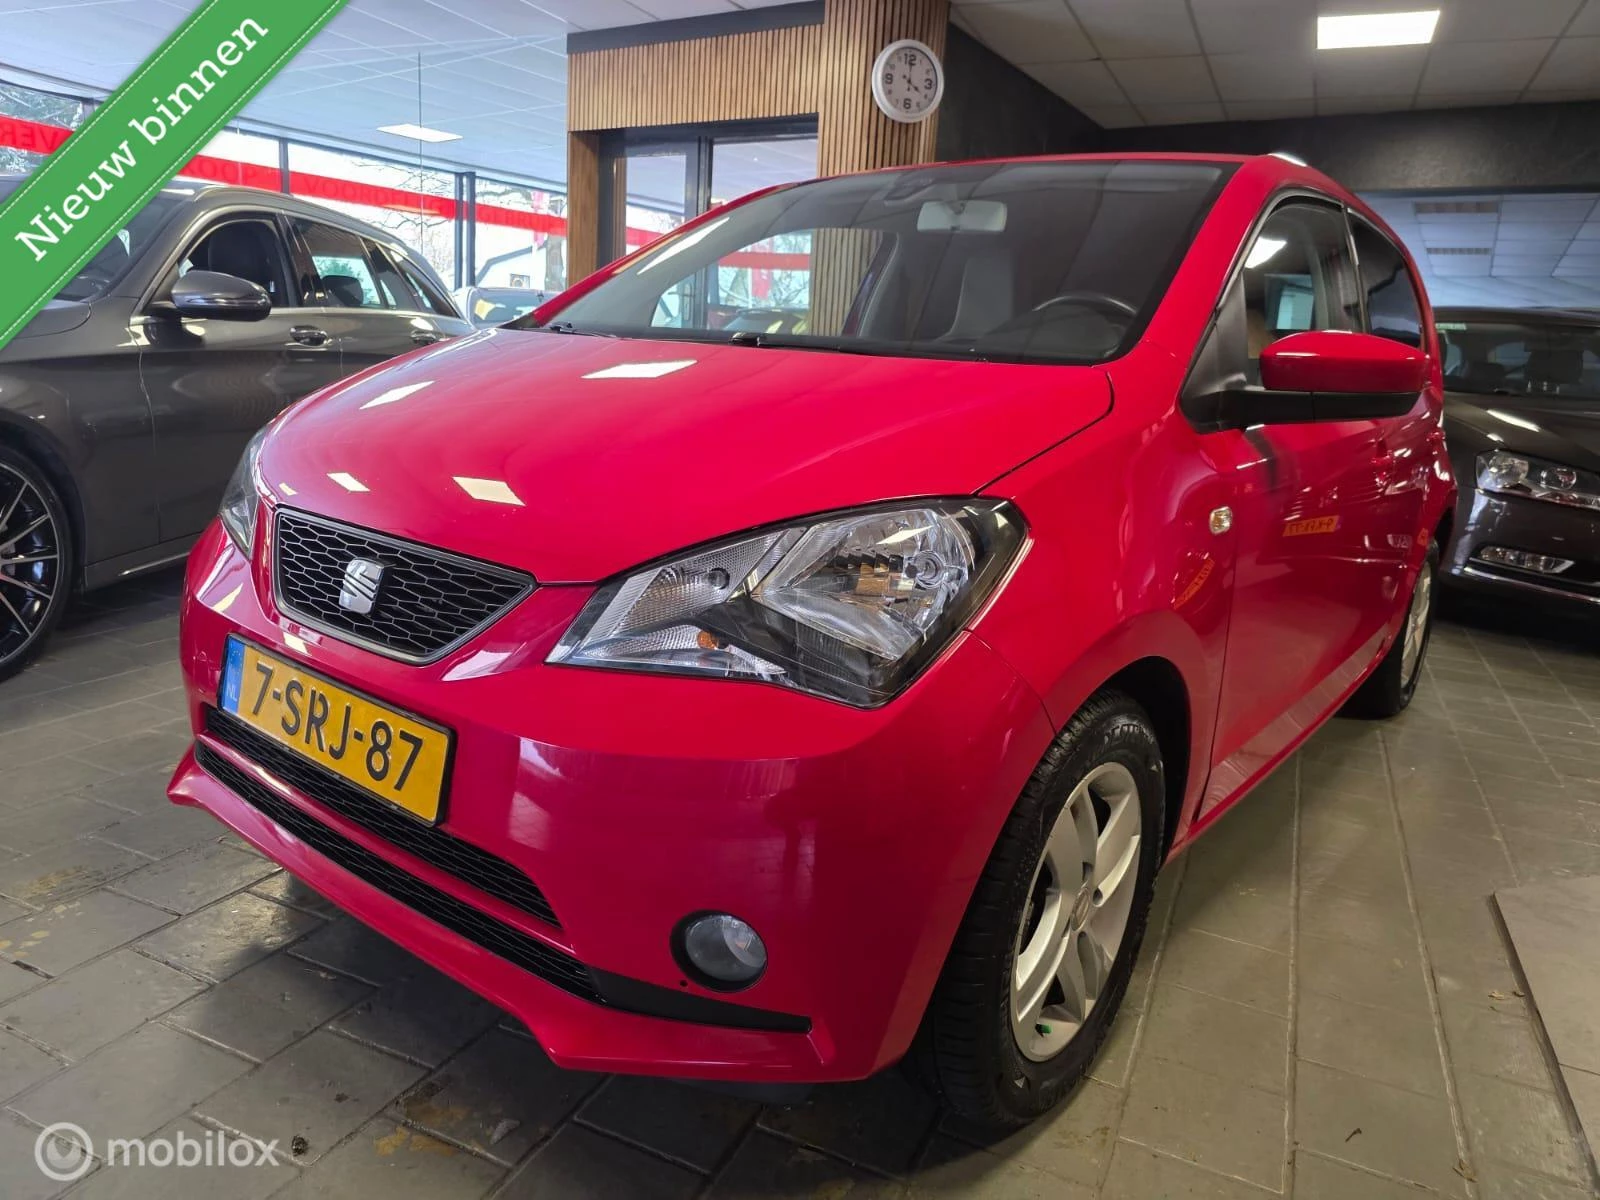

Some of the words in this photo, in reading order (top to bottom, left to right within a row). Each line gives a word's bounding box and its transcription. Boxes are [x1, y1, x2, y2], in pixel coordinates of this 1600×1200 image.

[904, 53, 916, 66] 12
[884, 73, 893, 85] 9
[924, 78, 933, 90] 3
[903, 98, 911, 109] 6
[252, 660, 424, 792] 7-SRJ-87
